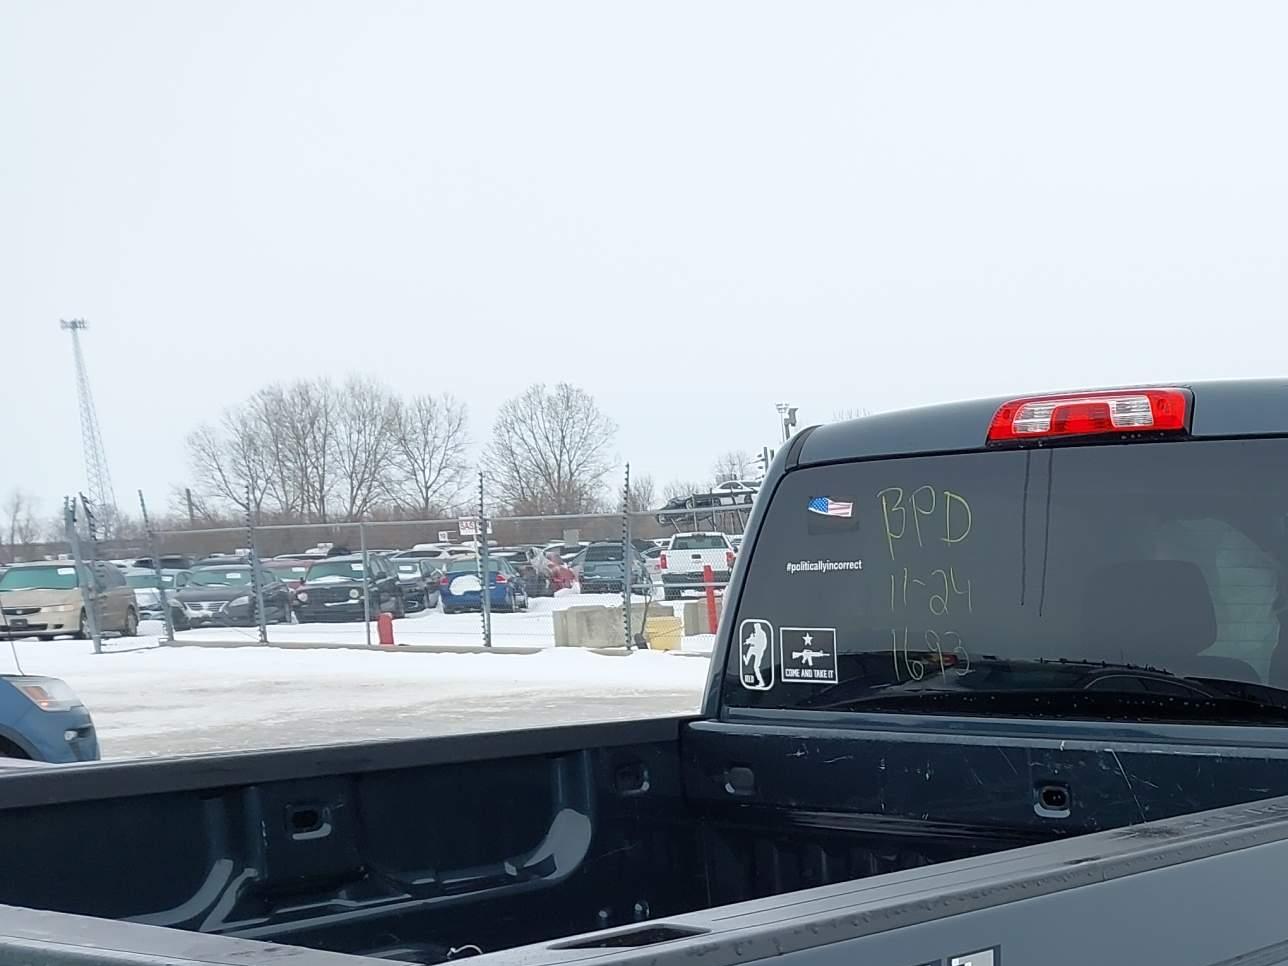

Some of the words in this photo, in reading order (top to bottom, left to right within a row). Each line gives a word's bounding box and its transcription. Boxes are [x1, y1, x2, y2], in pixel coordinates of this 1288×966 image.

[877, 485, 972, 560] BPD
[786, 559, 863, 574] #politicallyincorrect
[891, 567, 973, 616] 11-24
[785, 668, 800, 678] COME
[801, 668, 813, 678] AND
[813, 669, 828, 679] TAKE
[828, 669, 834, 679] IT
